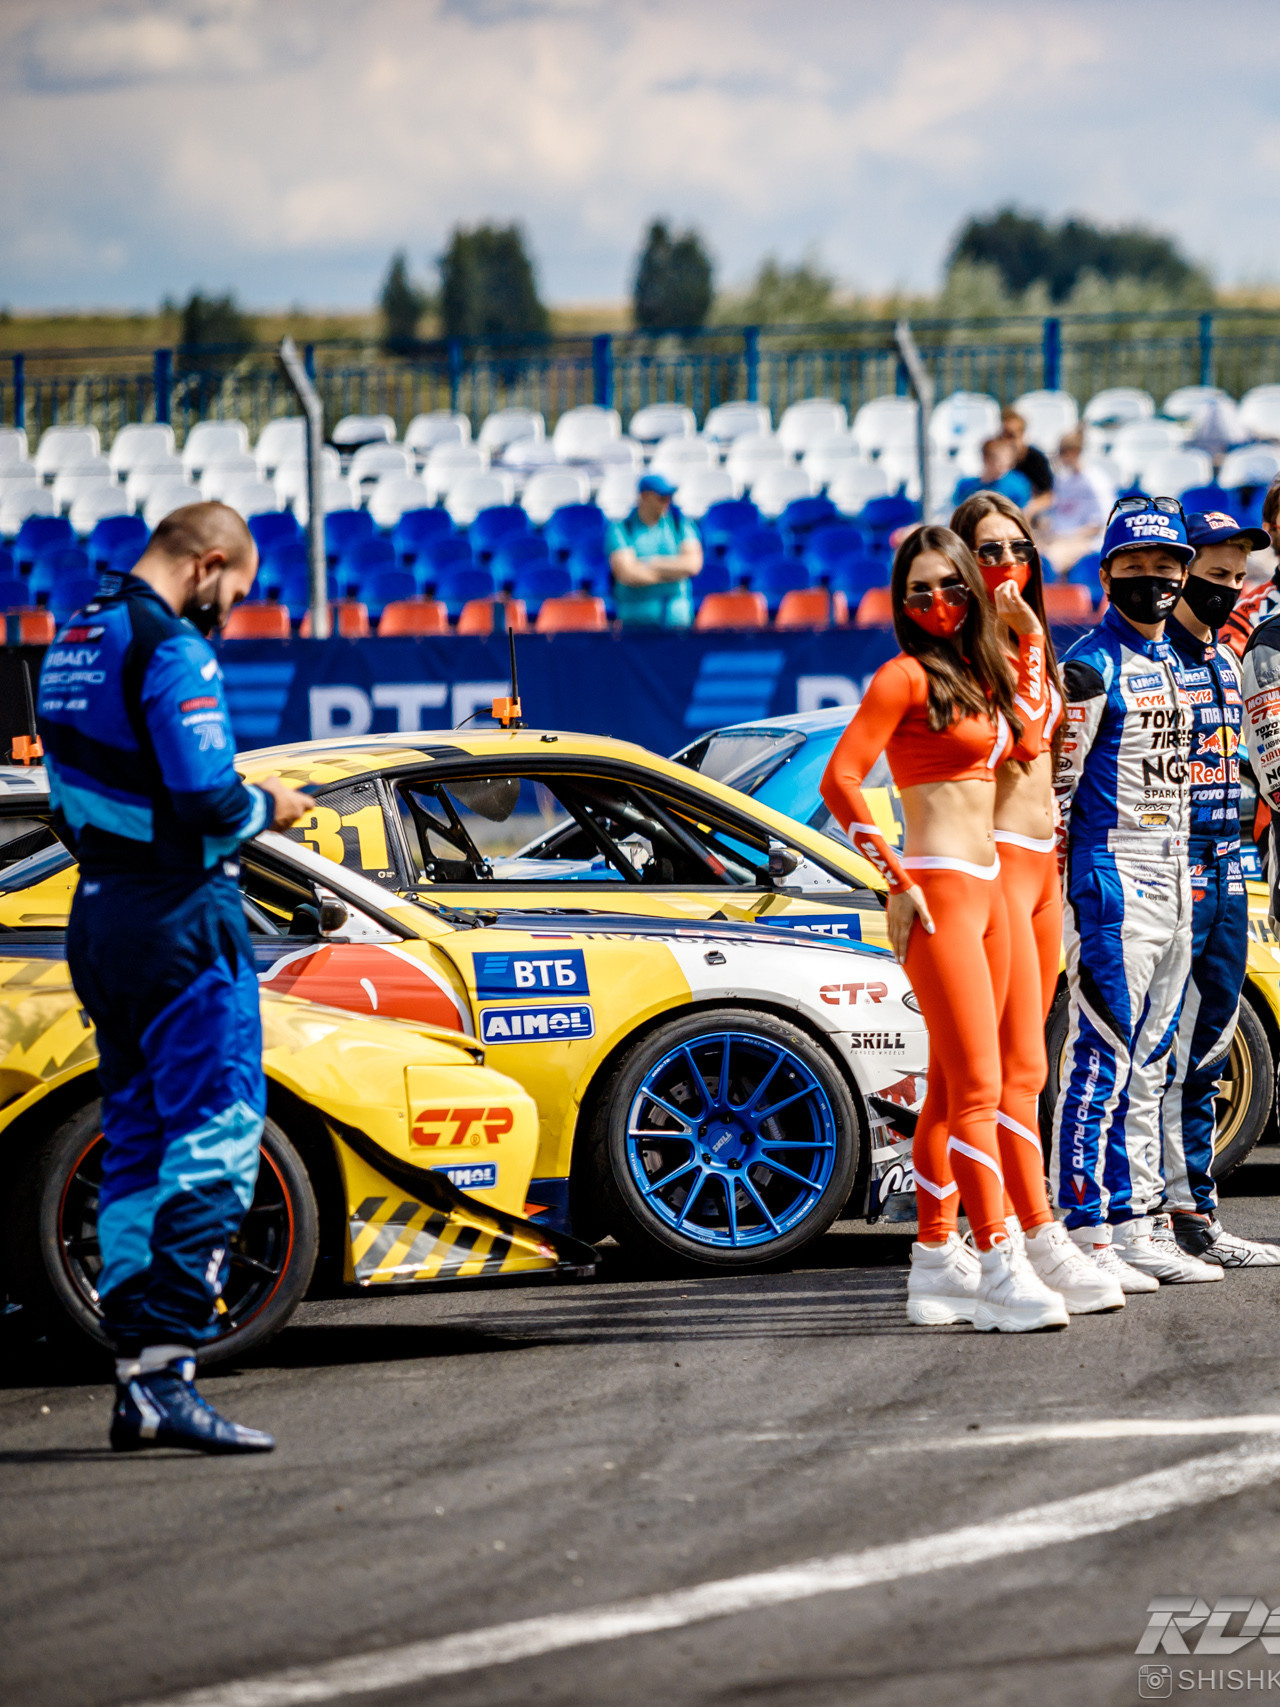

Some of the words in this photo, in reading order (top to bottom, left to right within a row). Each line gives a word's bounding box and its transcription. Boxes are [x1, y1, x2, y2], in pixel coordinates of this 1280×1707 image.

[1125, 514, 1170, 528] TOYO
[1132, 525, 1179, 541] TIRES
[1029, 646, 1041, 701] KYB
[1136, 694, 1166, 708] KYB
[1255, 721, 1279, 737] TOYO
[1190, 758, 1227, 785] Red
[1144, 789, 1176, 799] SPARK
[1192, 787, 1225, 800] TOYO
[1134, 803, 1172, 812] RAYS
[288, 805, 389, 871] 31
[514, 958, 578, 988] ВТБ
[819, 981, 889, 1006] CTR
[486, 1012, 590, 1037] AIMOL
[851, 1032, 906, 1049] SKILL
[1077, 1048, 1100, 1125] FORWARD
[411, 1107, 514, 1146] CTR
[712, 1131, 733, 1153] SKILL
[1072, 1122, 1086, 1169] AUTO
[447, 1168, 495, 1187] IMOL
